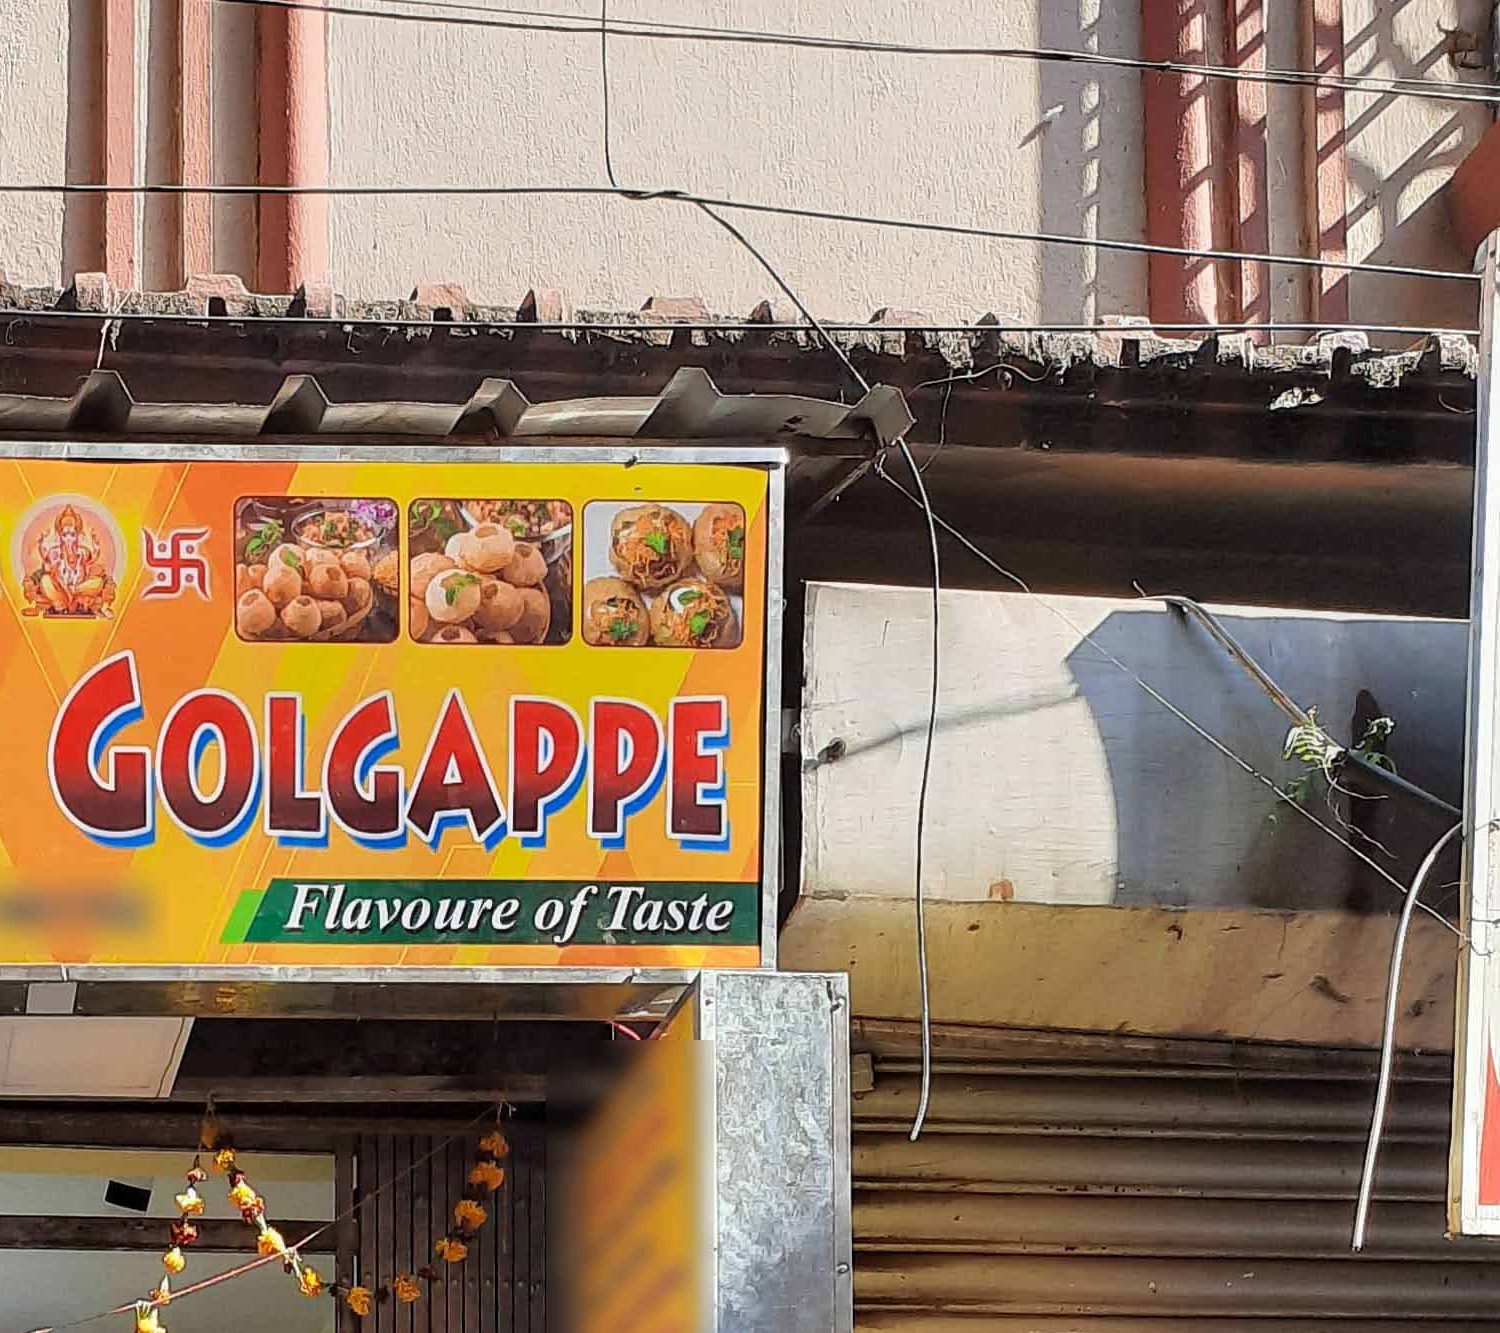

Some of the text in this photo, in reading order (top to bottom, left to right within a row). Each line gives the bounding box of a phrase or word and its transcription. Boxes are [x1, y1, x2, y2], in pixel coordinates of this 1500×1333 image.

[48, 649, 731, 851] GOLGAPPE
[283, 883, 736, 943] Flavoure of Taste
